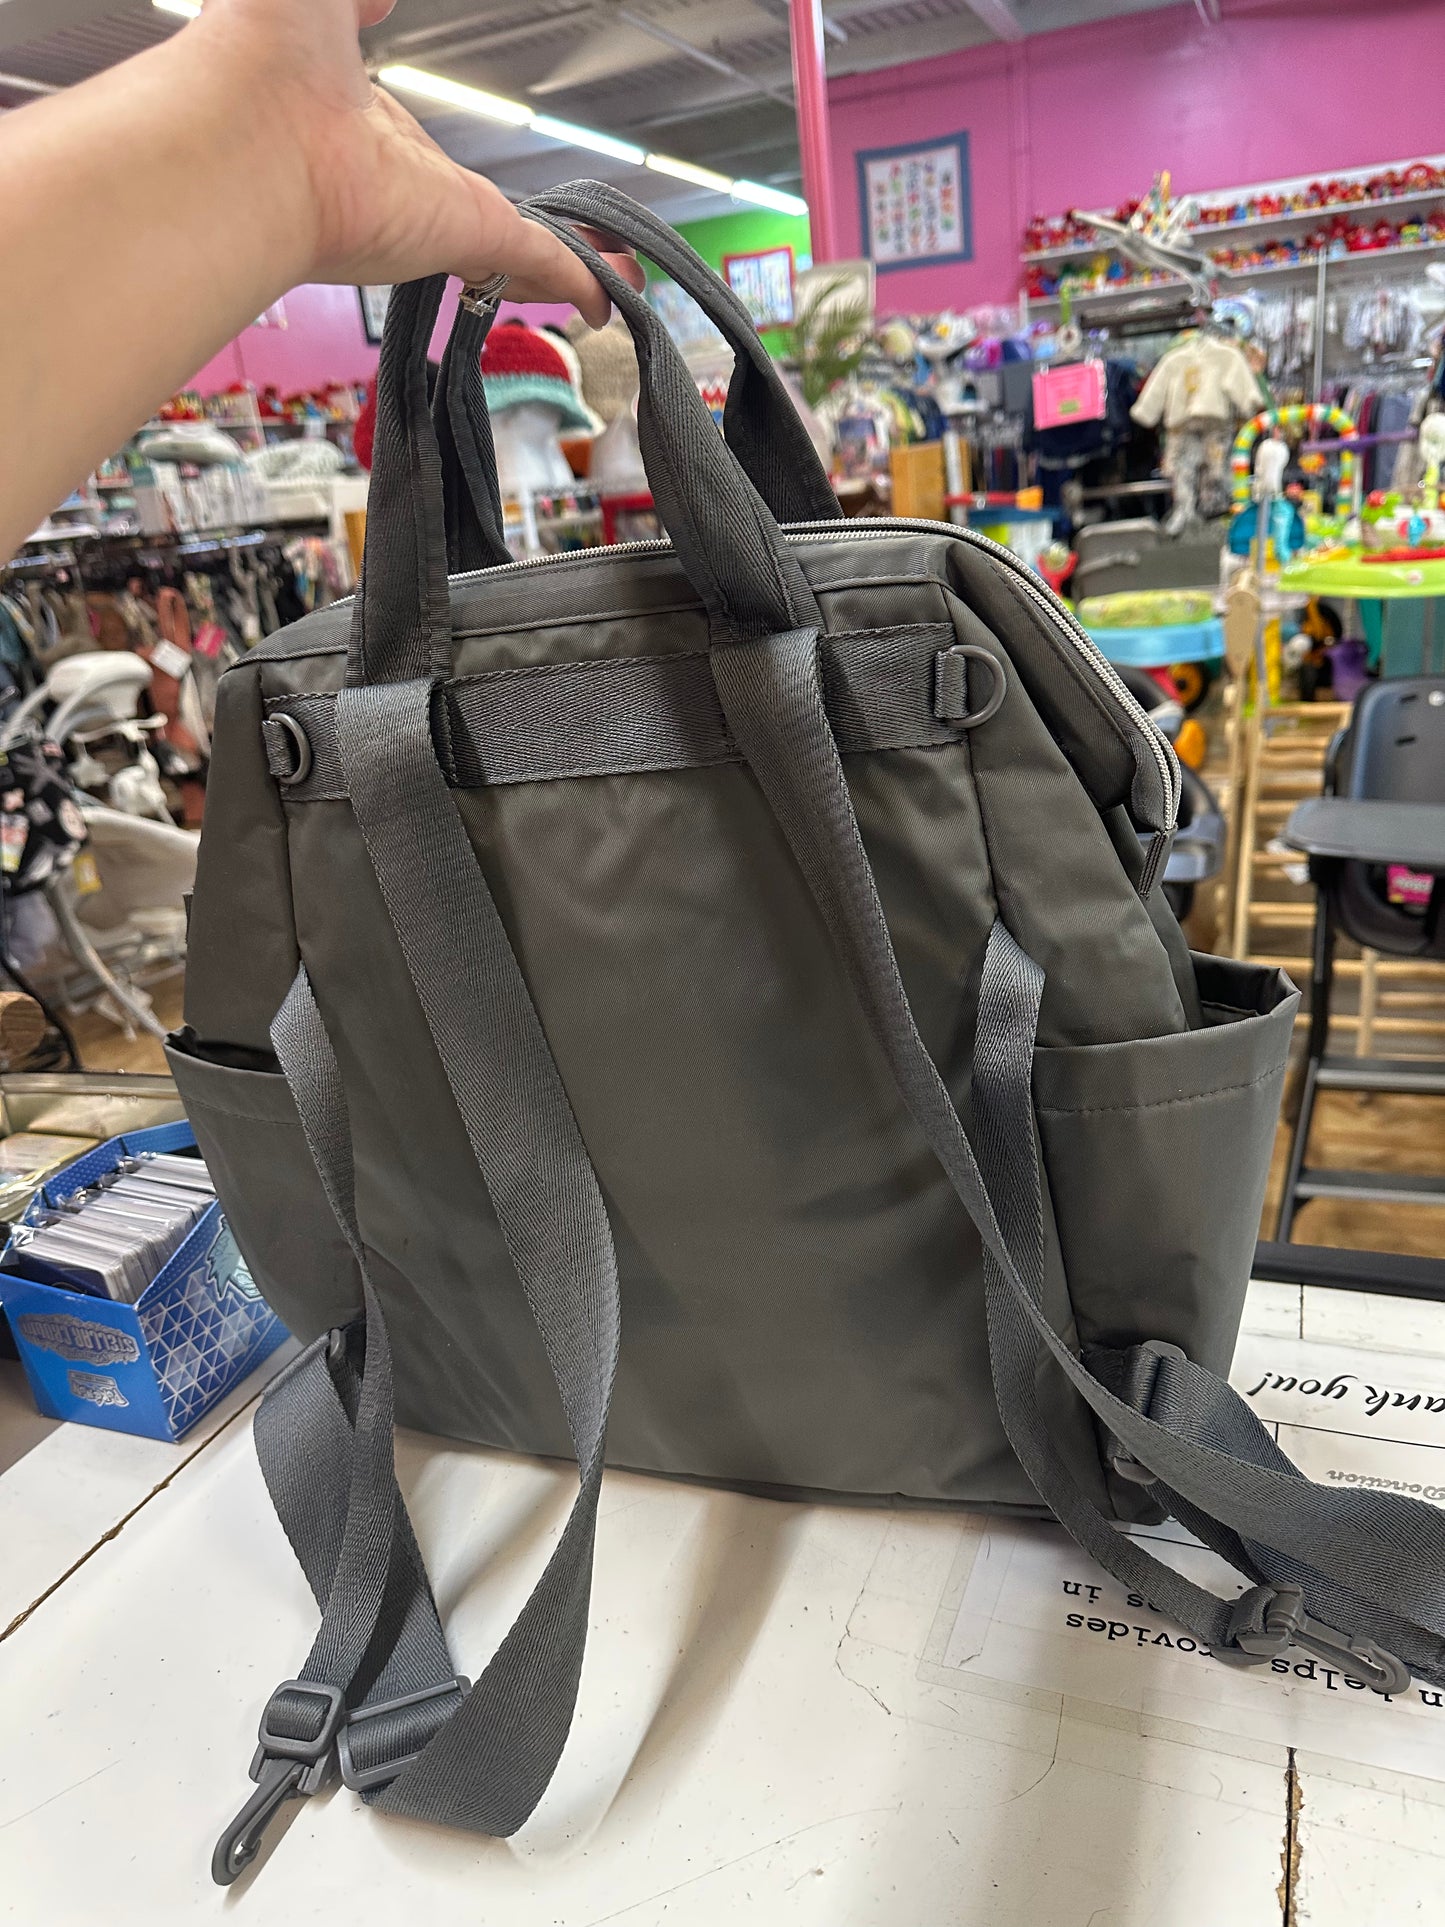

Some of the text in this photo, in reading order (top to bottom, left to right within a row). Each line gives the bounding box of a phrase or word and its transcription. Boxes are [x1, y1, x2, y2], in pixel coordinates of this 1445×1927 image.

[72, 1326, 136, 1353] STELLAR
[1246, 1371, 1445, 1417] ank you!
[1327, 1469, 1445, 1501] Donation
[1062, 1580, 1103, 1604] in
[1065, 1613, 1215, 1659] rovides
